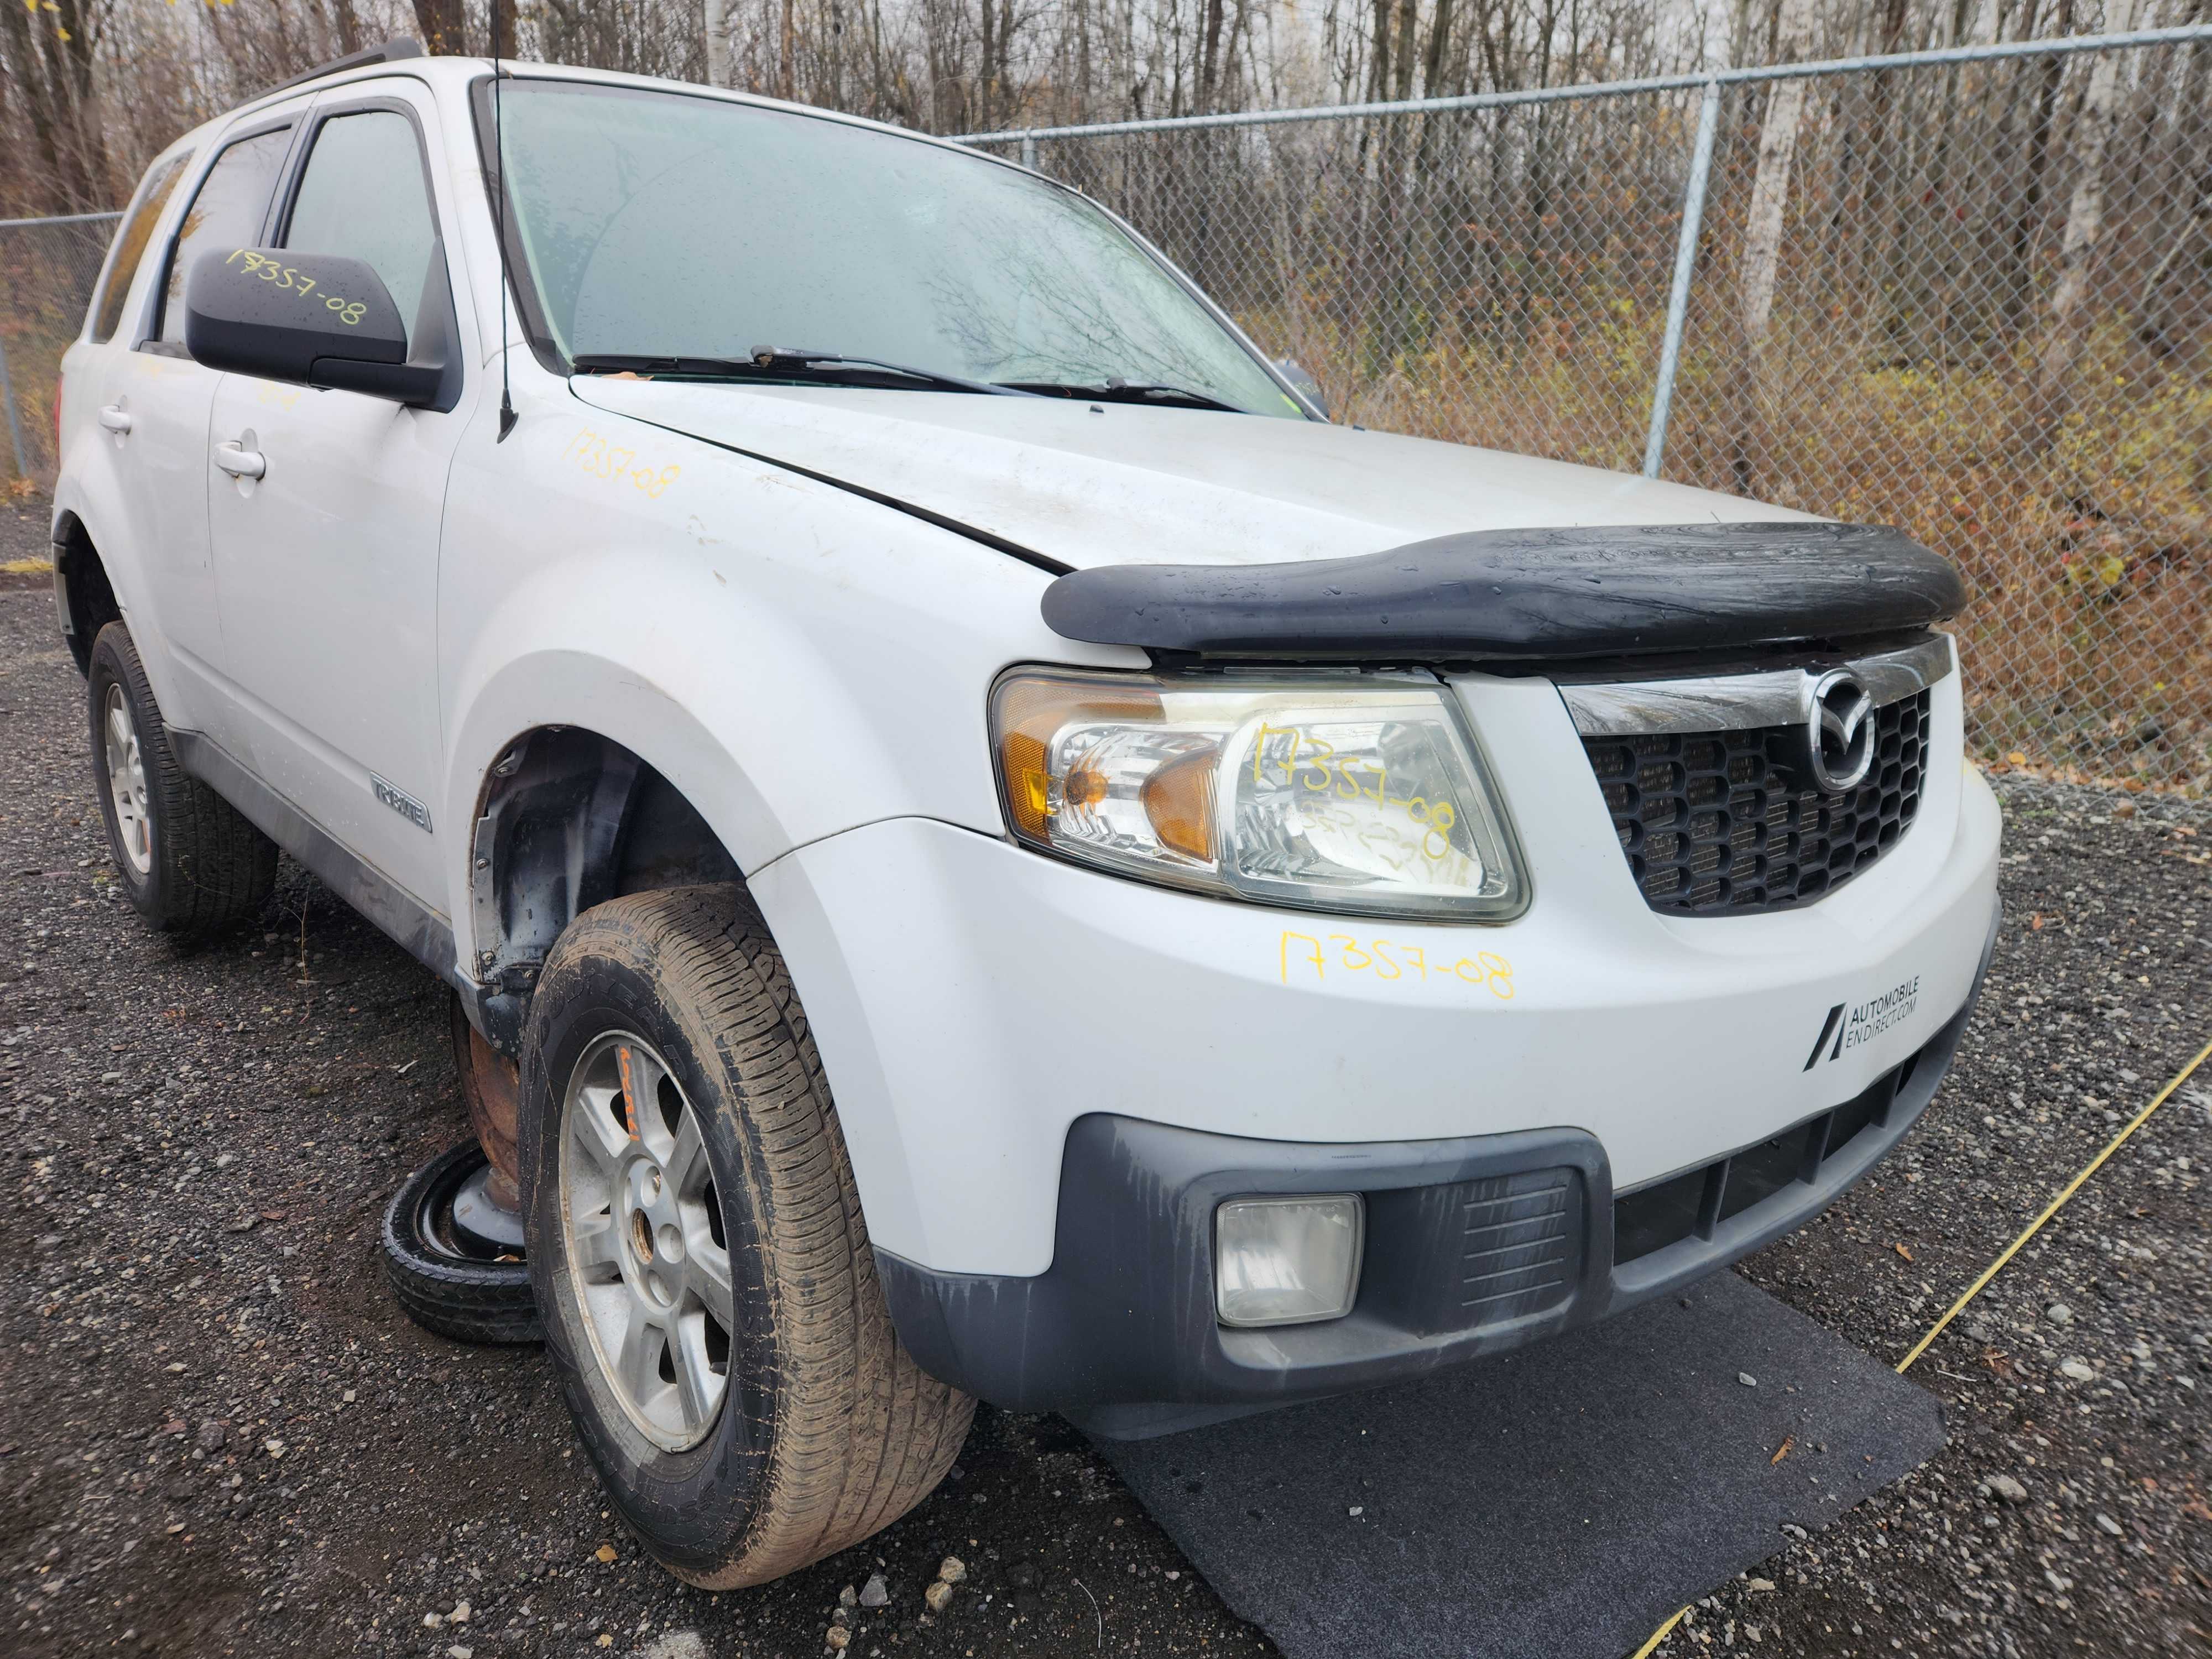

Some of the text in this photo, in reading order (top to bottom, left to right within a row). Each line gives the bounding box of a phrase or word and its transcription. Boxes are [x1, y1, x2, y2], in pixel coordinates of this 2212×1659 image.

[226, 248, 367, 325] 17357-08
[372, 778, 425, 826] TRIBUTE
[1254, 722, 1455, 860] 17357-08
[1280, 931, 1515, 1000] 17357-08
[1846, 996, 1917, 1049] ENDIRECT.COM
[1849, 974, 1920, 1027] AUTOMOBILE
